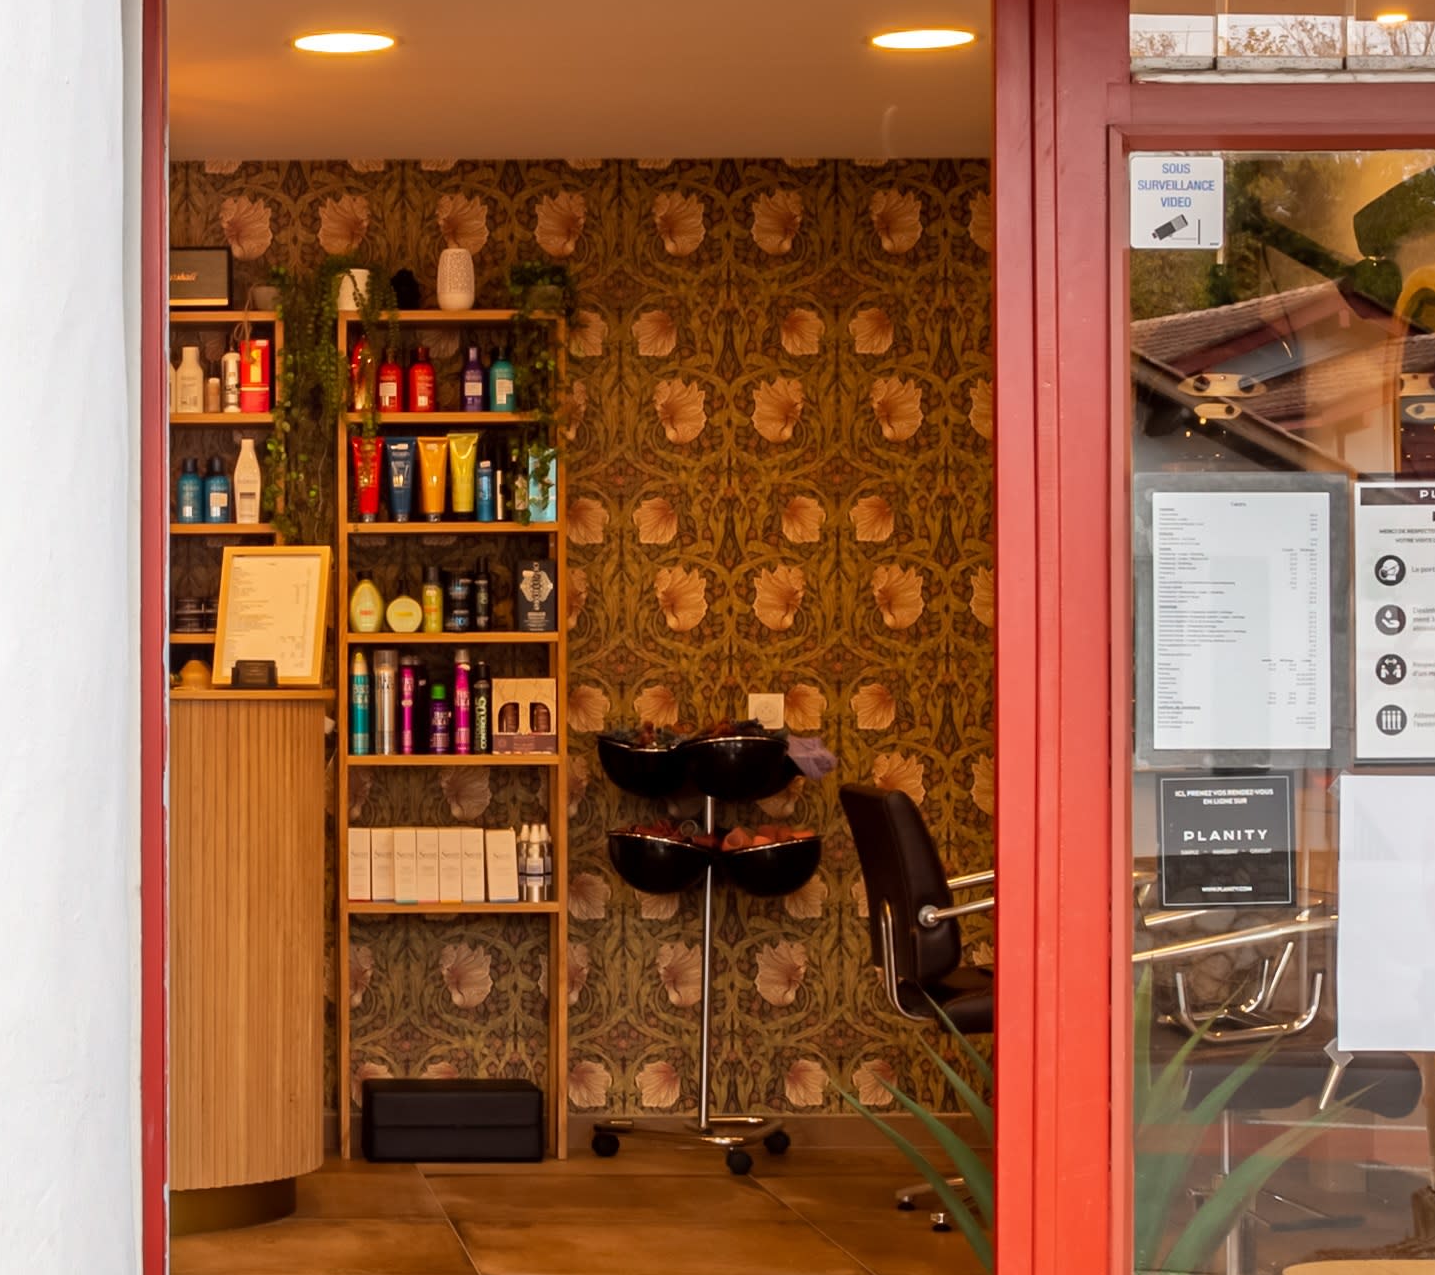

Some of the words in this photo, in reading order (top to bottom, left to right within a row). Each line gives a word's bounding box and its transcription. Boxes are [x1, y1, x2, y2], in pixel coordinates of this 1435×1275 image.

[1162, 163, 1191, 174] SOUS
[1137, 180, 1215, 191] SURVEILLANCE
[1160, 196, 1192, 208] VIDEO
[1183, 829, 1268, 842] PLANITY
